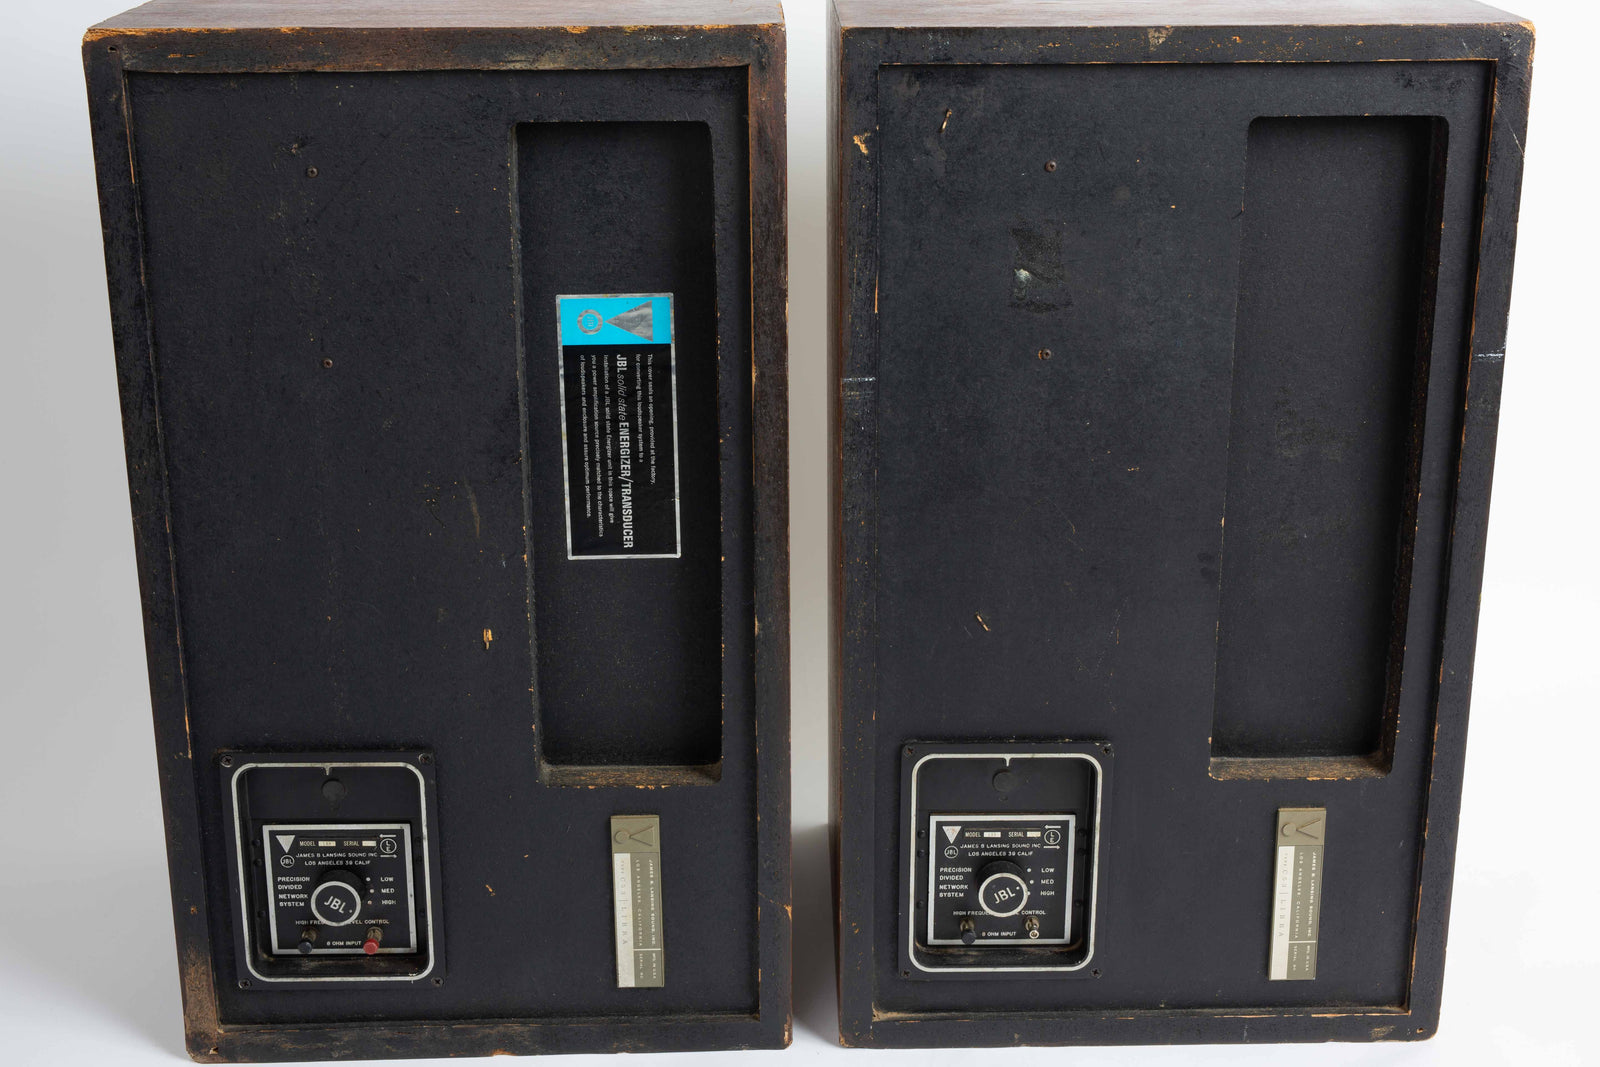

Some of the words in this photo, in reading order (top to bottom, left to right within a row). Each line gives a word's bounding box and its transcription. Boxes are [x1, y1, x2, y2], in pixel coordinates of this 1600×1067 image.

[617, 354, 628, 372] JBL
[617, 374, 627, 396] solid
[618, 398, 627, 420] state
[618, 422, 634, 548] ENERGIZER/TRANSDUCER
[324, 896, 346, 914] JBL
[994, 887, 1016, 904] JBL
